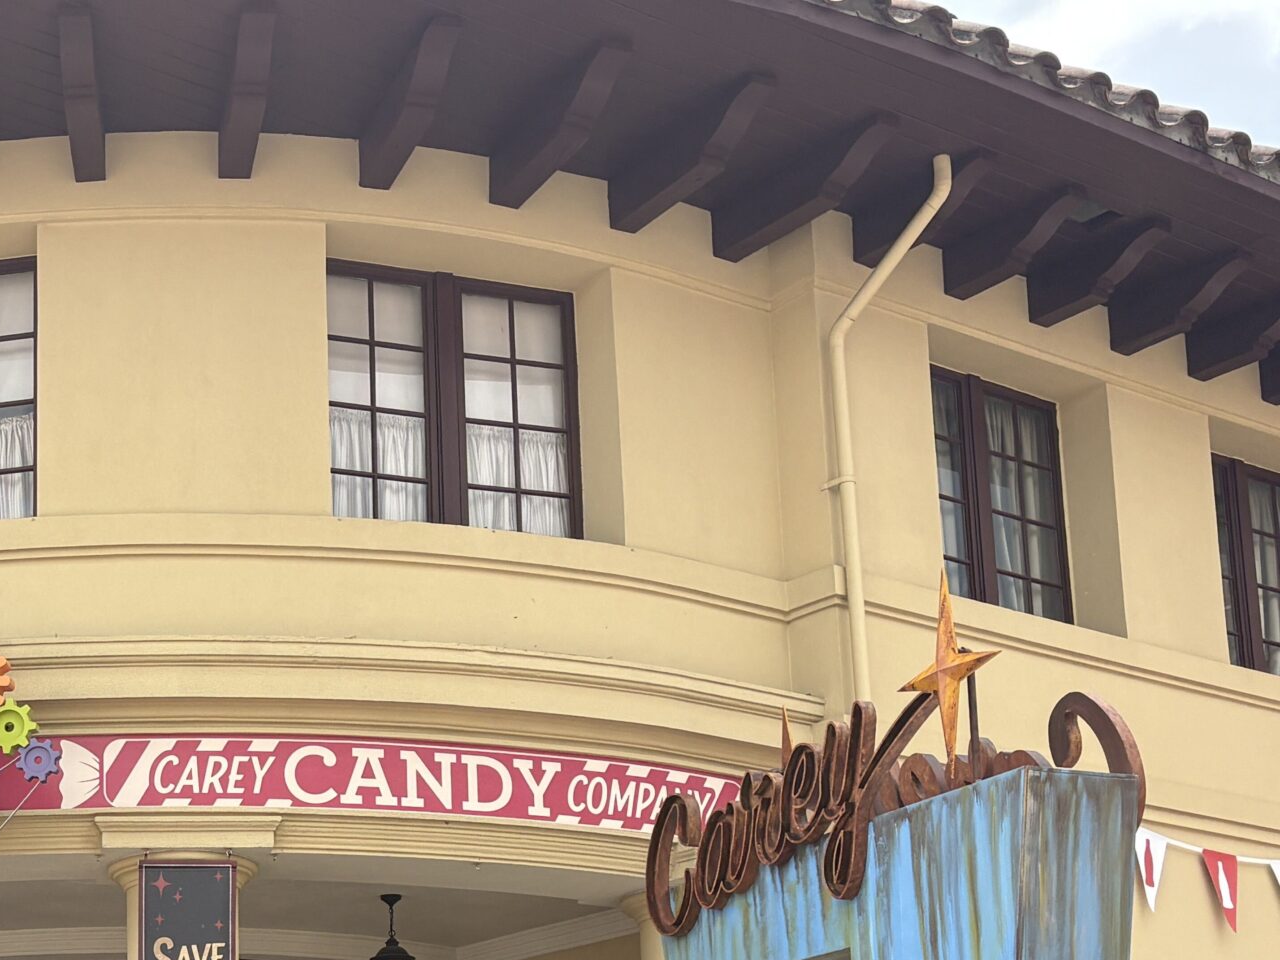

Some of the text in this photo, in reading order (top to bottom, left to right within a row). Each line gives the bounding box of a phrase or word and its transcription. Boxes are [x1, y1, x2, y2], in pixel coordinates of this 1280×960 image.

[153, 745, 711, 820] CAREY CANDY COMPAY
[646, 694, 935, 937] Carey
